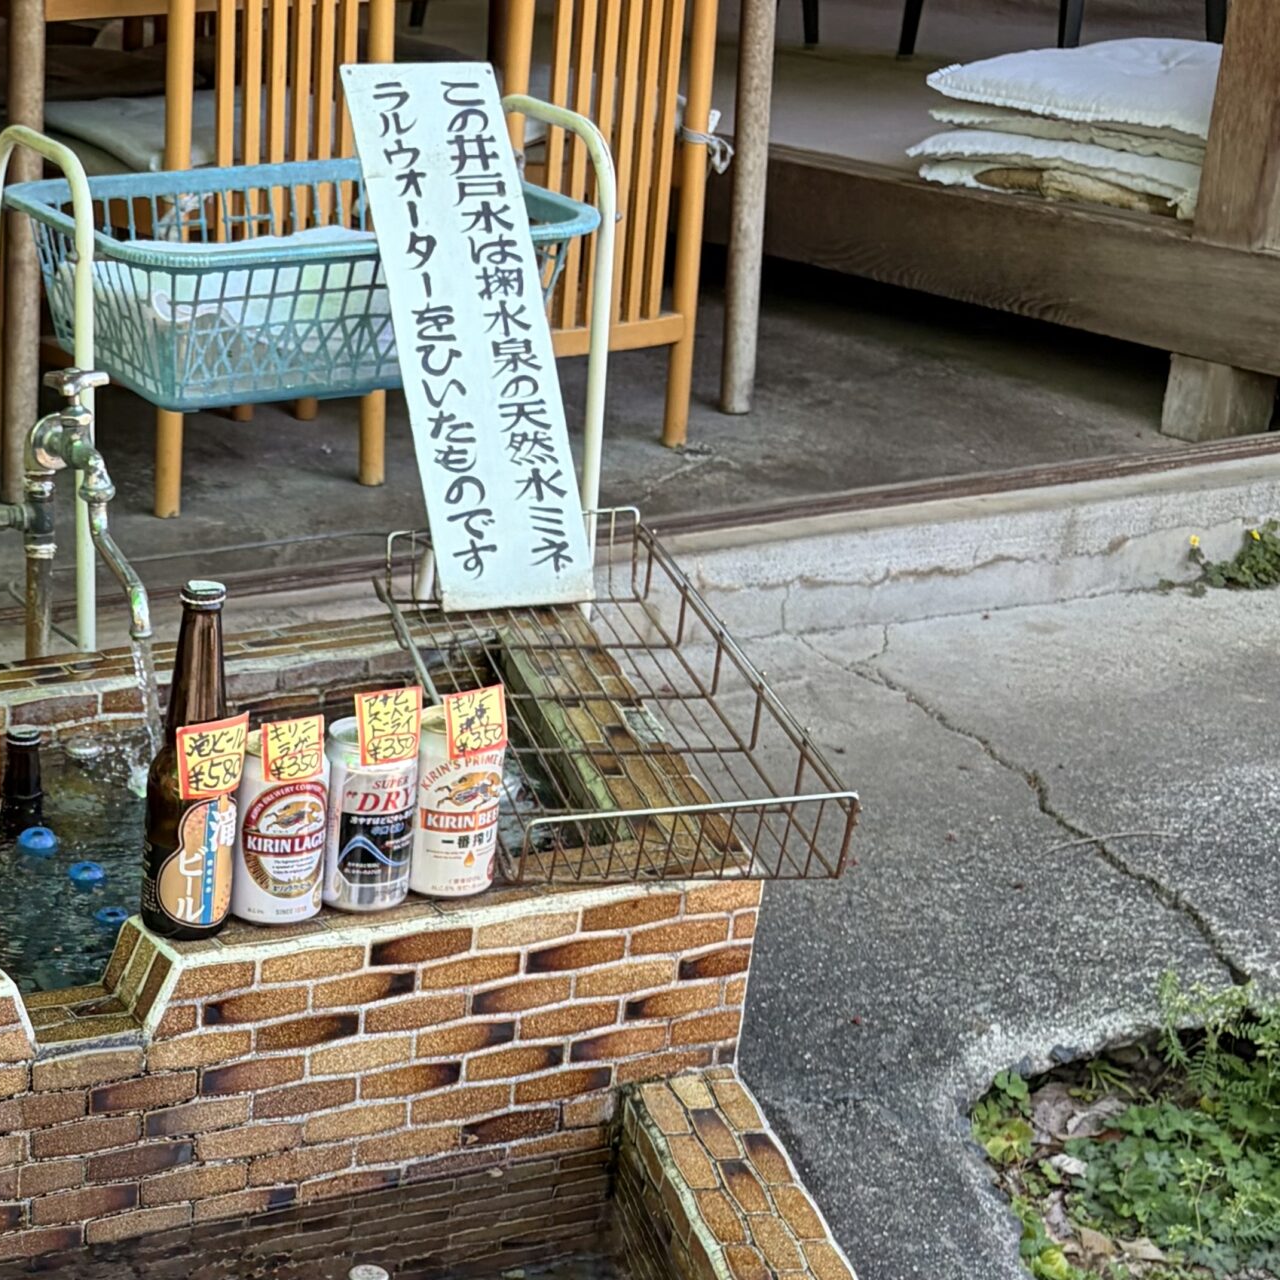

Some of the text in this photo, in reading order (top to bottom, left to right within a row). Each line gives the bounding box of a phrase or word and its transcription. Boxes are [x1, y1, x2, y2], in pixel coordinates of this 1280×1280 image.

[270, 721, 317, 741] キリン
[370, 718, 413, 736] ドライ
[278, 737, 320, 757] ラガー
[369, 737, 415, 762] ¥350
[457, 727, 503, 755] ¥350
[189, 759, 240, 791] ¥580
[271, 753, 319, 781] ¥350
[421, 759, 461, 791] KIRIN'S
[464, 754, 499, 768] PRIME
[372, 776, 408, 790] SUPER
[427, 813, 474, 830] KIRIN
[247, 835, 291, 854] KIRIN
[441, 829, 493, 849] 一番搾り
[175, 846, 207, 923] ビール
